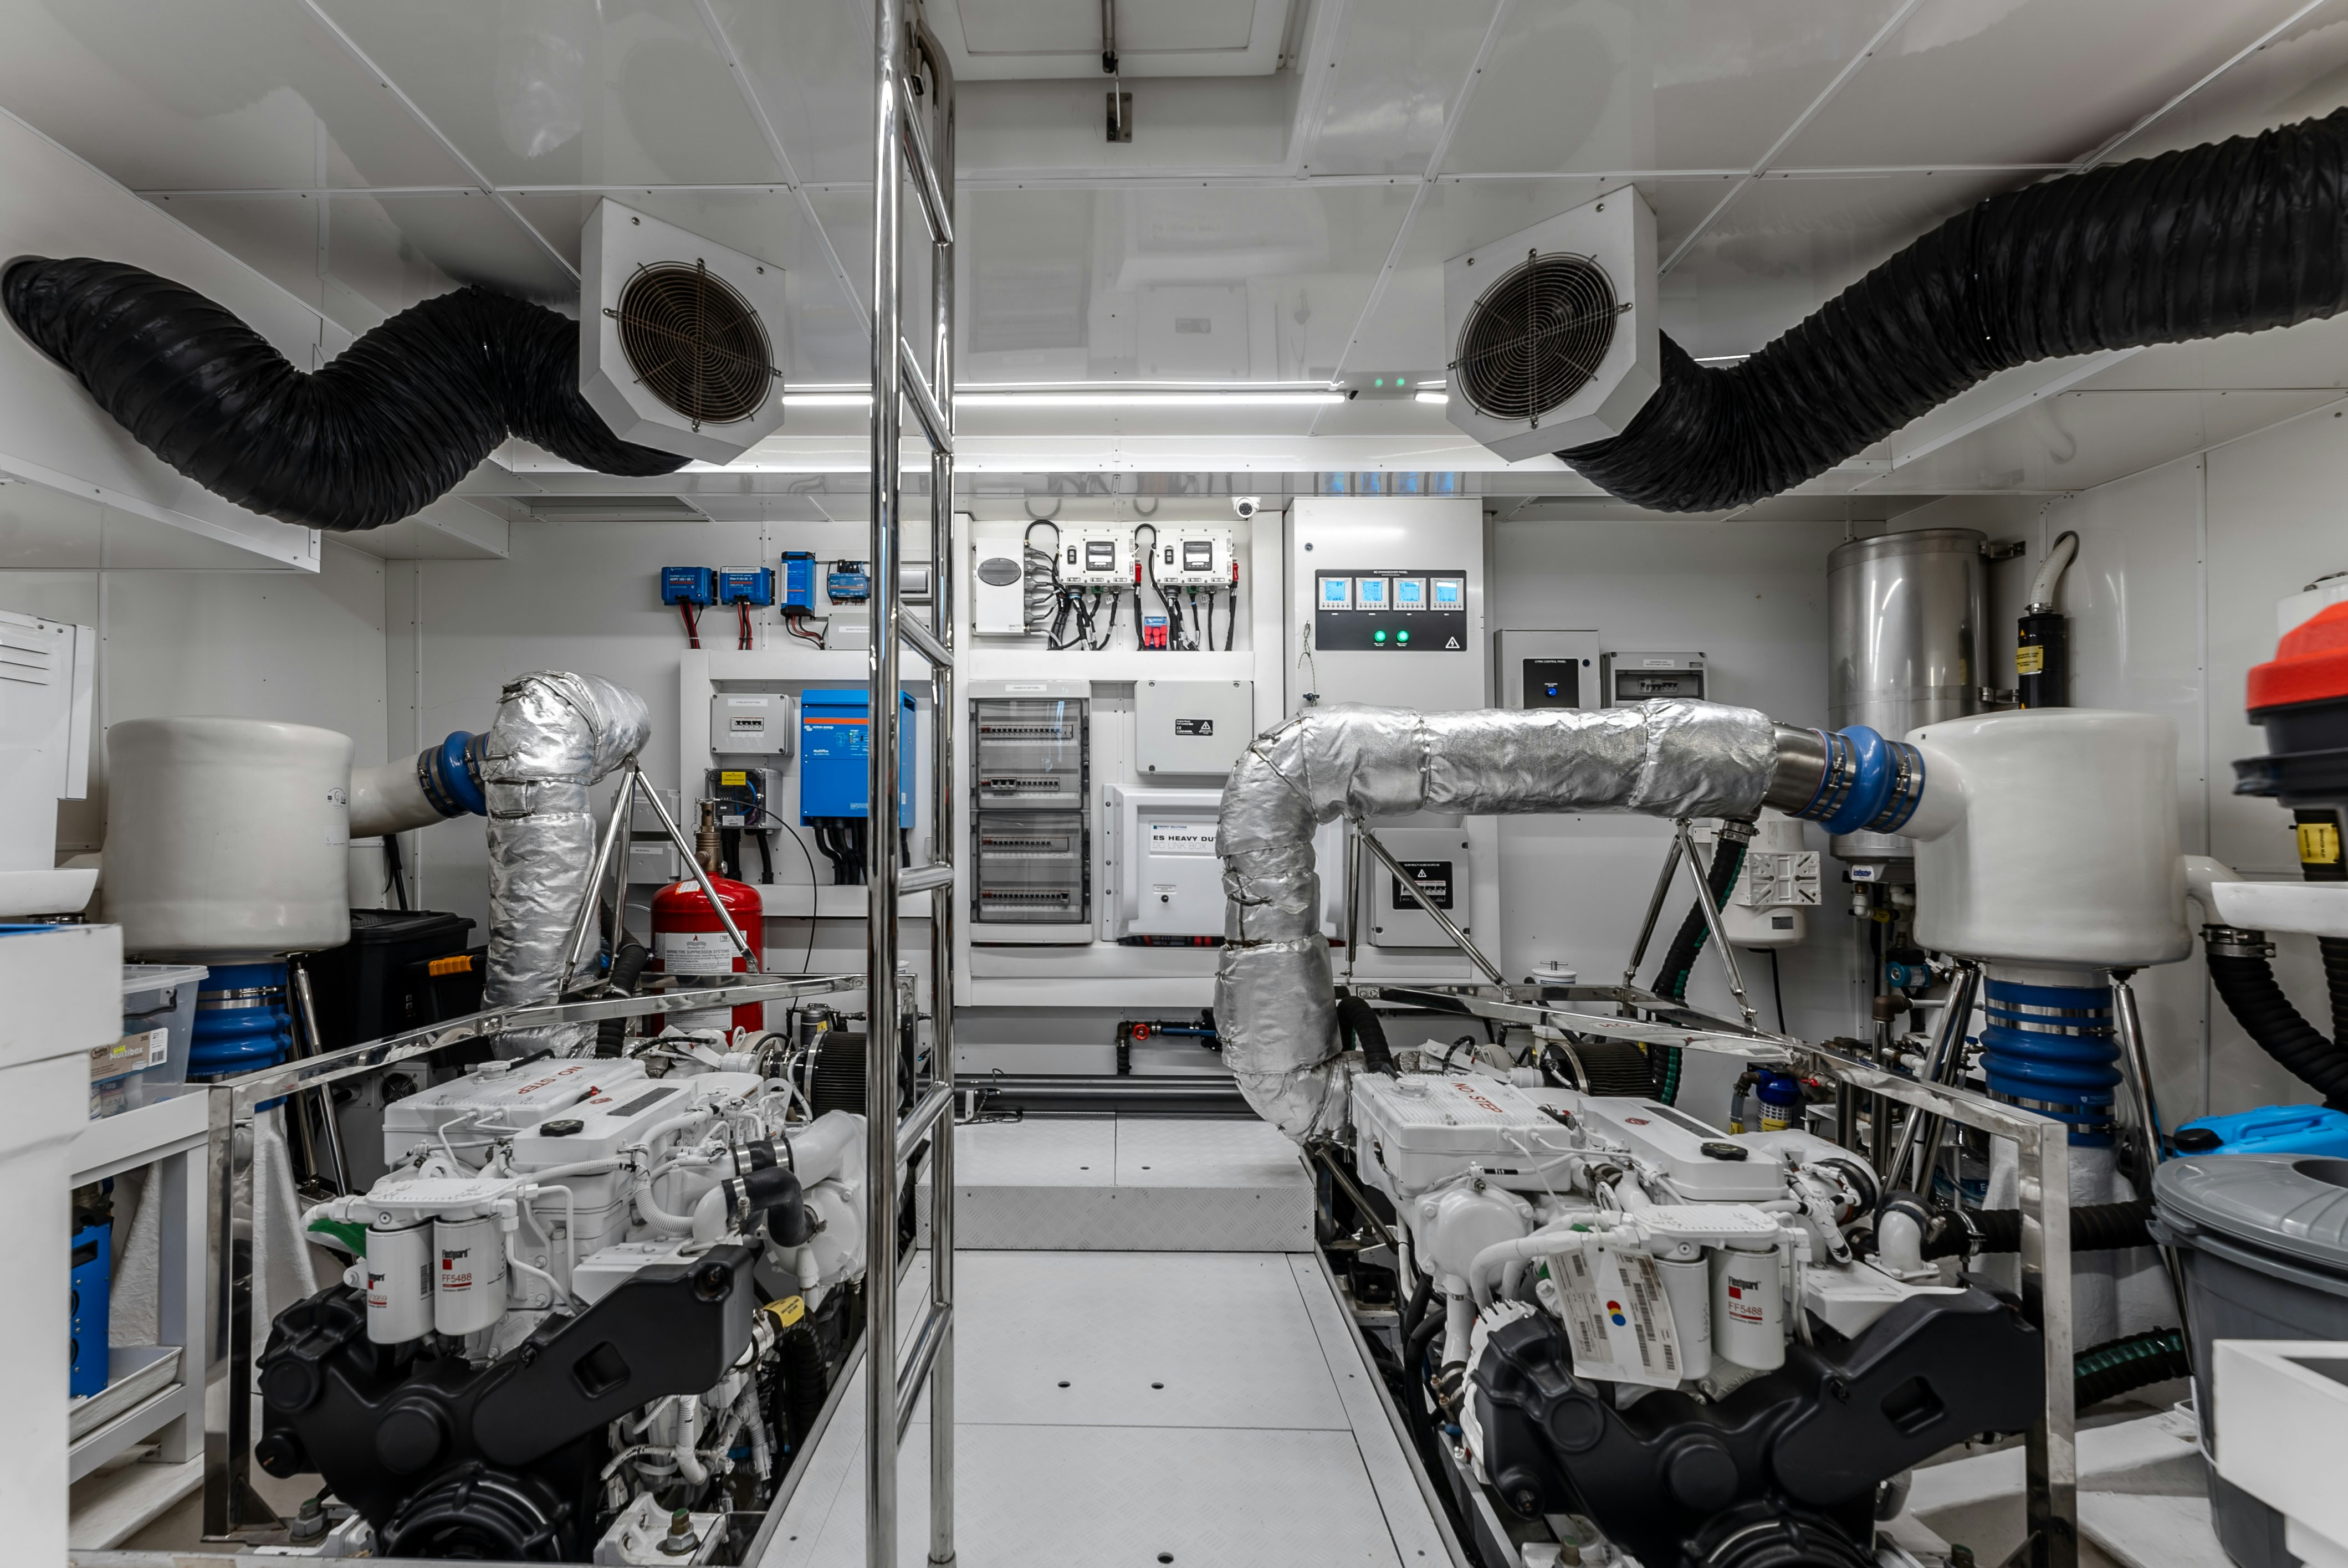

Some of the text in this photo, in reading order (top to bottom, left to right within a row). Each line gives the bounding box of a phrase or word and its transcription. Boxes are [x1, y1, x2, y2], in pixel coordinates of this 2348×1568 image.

[109, 1047, 144, 1060] Multibox
[518, 1066, 584, 1094] NO STEP
[1451, 1083, 1503, 1113] NO STEP
[442, 1273, 472, 1283] FF5488
[1728, 1275, 1758, 1290] Fleetguard
[1728, 1301, 1763, 1316] FF5488
